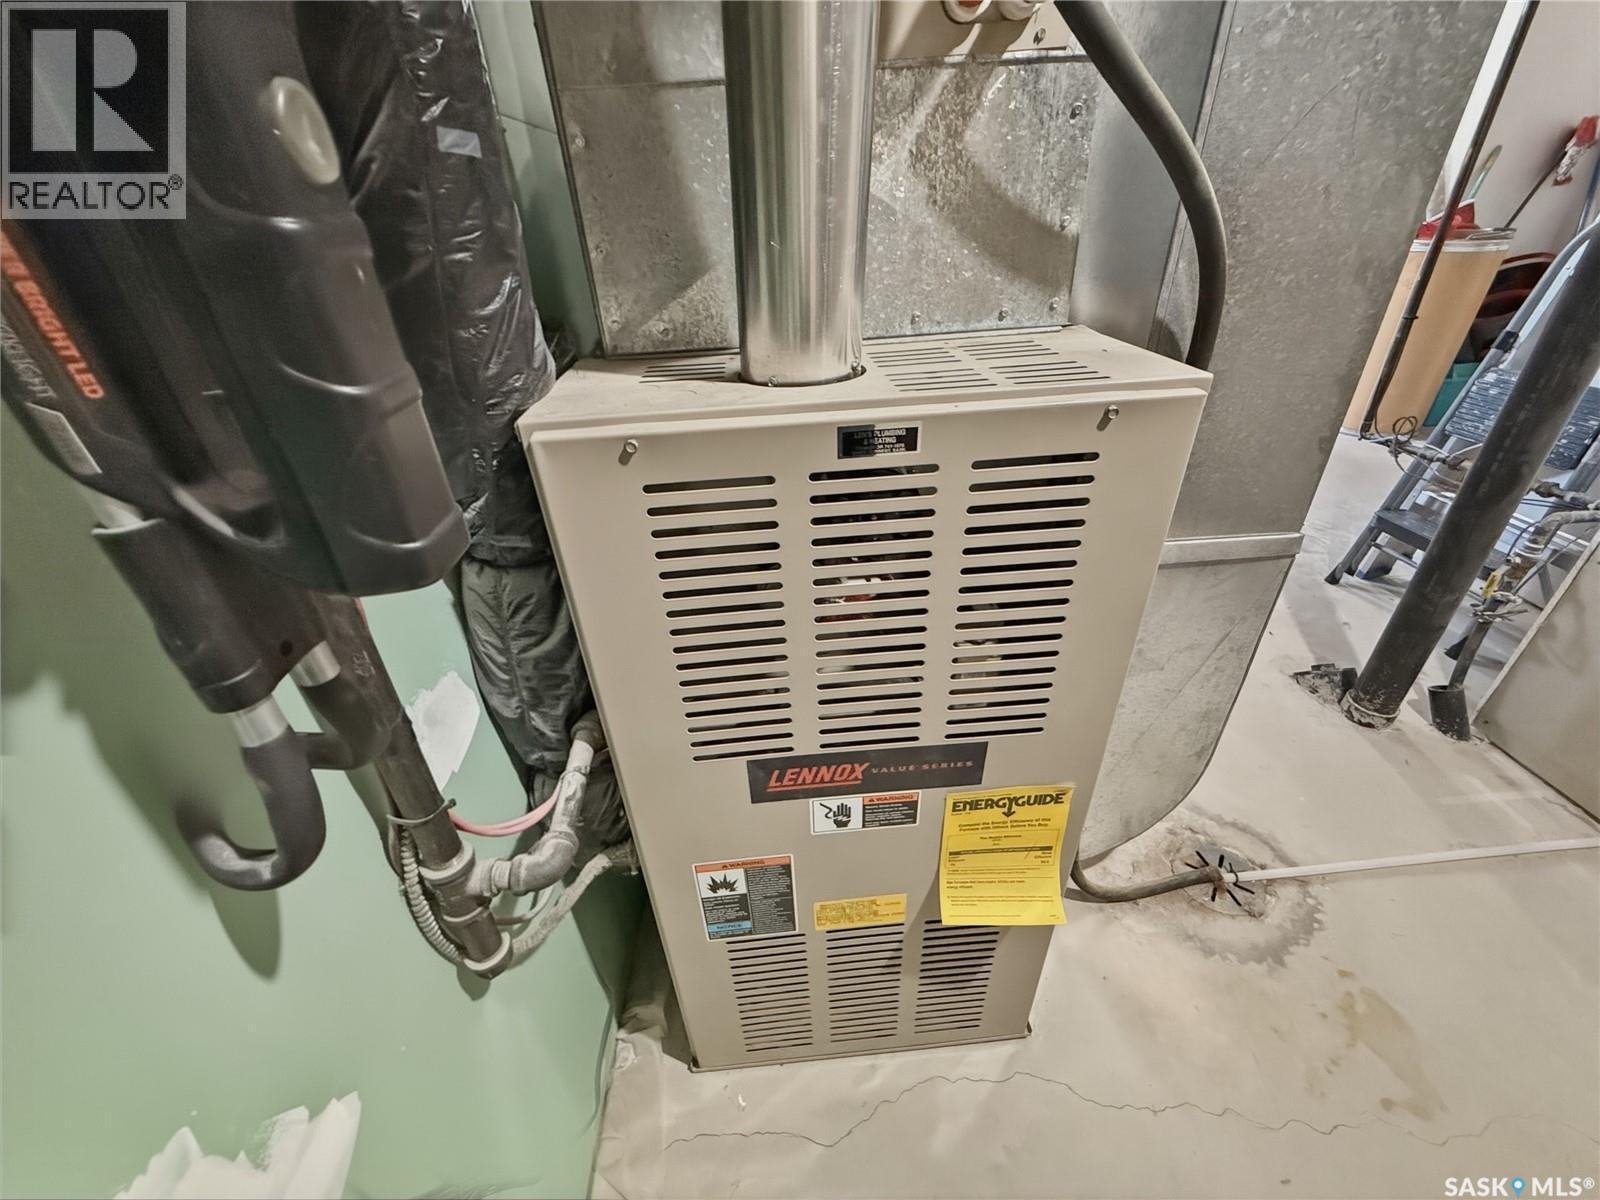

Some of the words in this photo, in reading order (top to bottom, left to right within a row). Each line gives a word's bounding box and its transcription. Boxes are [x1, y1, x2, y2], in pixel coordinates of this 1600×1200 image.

[14, 279, 82, 358] BRIGHT
[67, 361, 105, 398] LED
[768, 762, 870, 787] LENNOX
[871, 765, 915, 773] VALUE
[922, 760, 975, 769] SERIES
[951, 793, 1066, 815] ENERGYGUIDE
